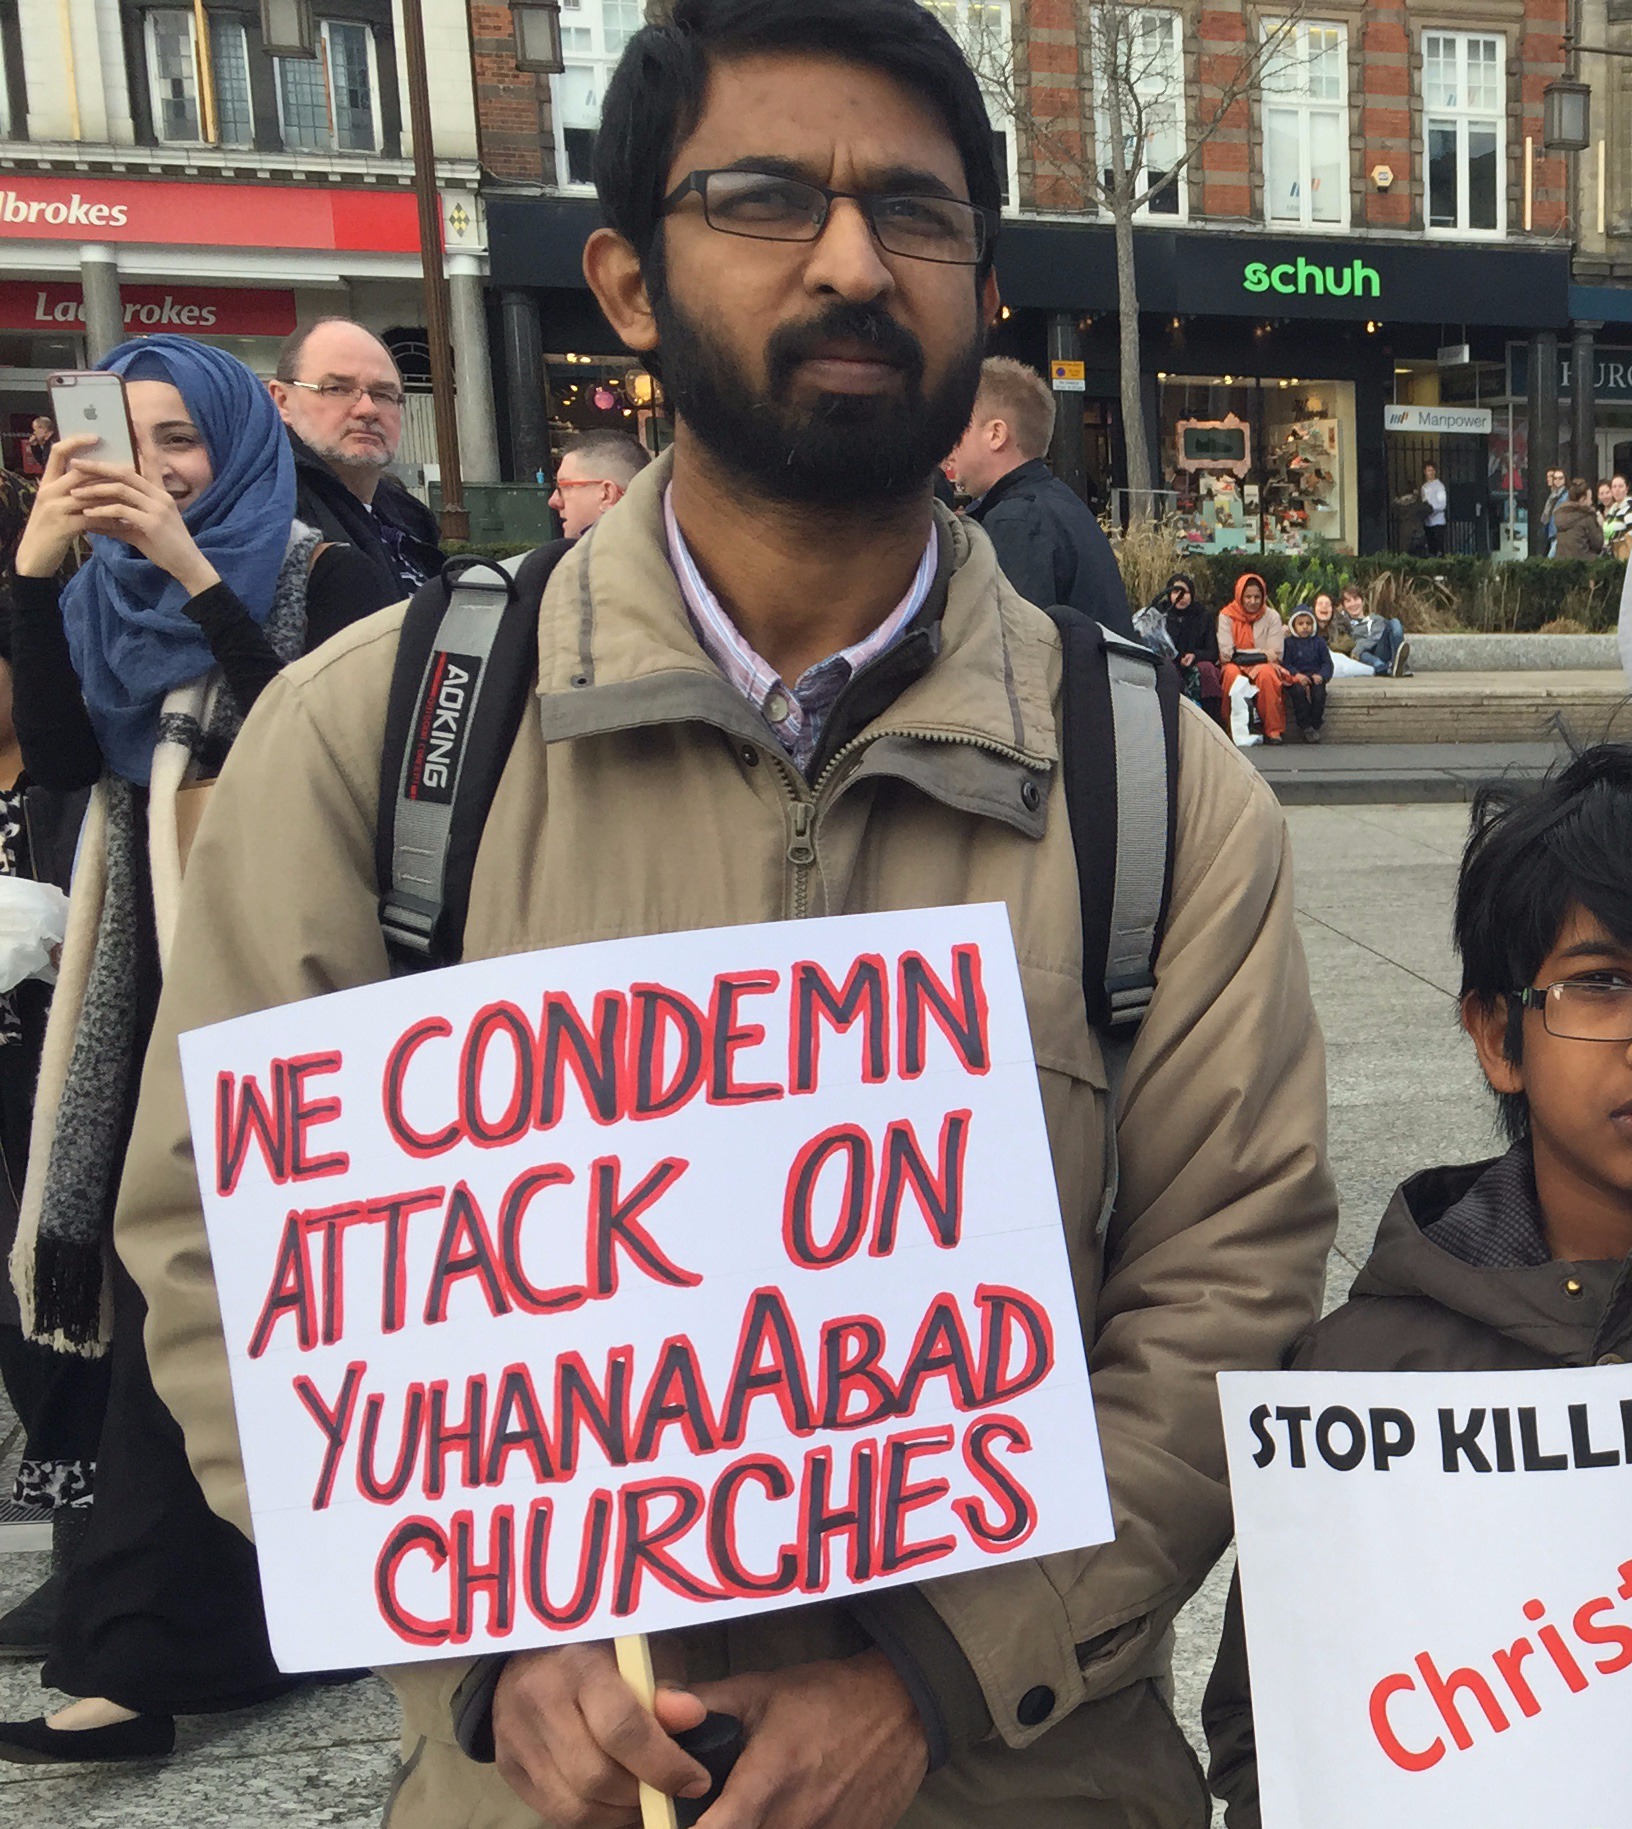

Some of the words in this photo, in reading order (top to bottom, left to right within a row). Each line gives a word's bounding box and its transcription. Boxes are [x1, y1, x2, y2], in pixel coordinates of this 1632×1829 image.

[0, 191, 128, 227] brokes
[35, 292, 217, 326] Larokes
[1243, 257, 1381, 297] schuh
[1418, 411, 1487, 429] Manpower
[423, 663, 469, 789] AOKING
[216, 1049, 350, 1197] WE
[382, 943, 992, 1161] CONDEMN
[247, 1154, 704, 1359] ATTACK
[781, 1108, 974, 1271] ON
[291, 1283, 1056, 1510] YUHANAABAD
[1250, 1404, 1416, 1472] STOP
[374, 1413, 1039, 1648] CHURCHES
